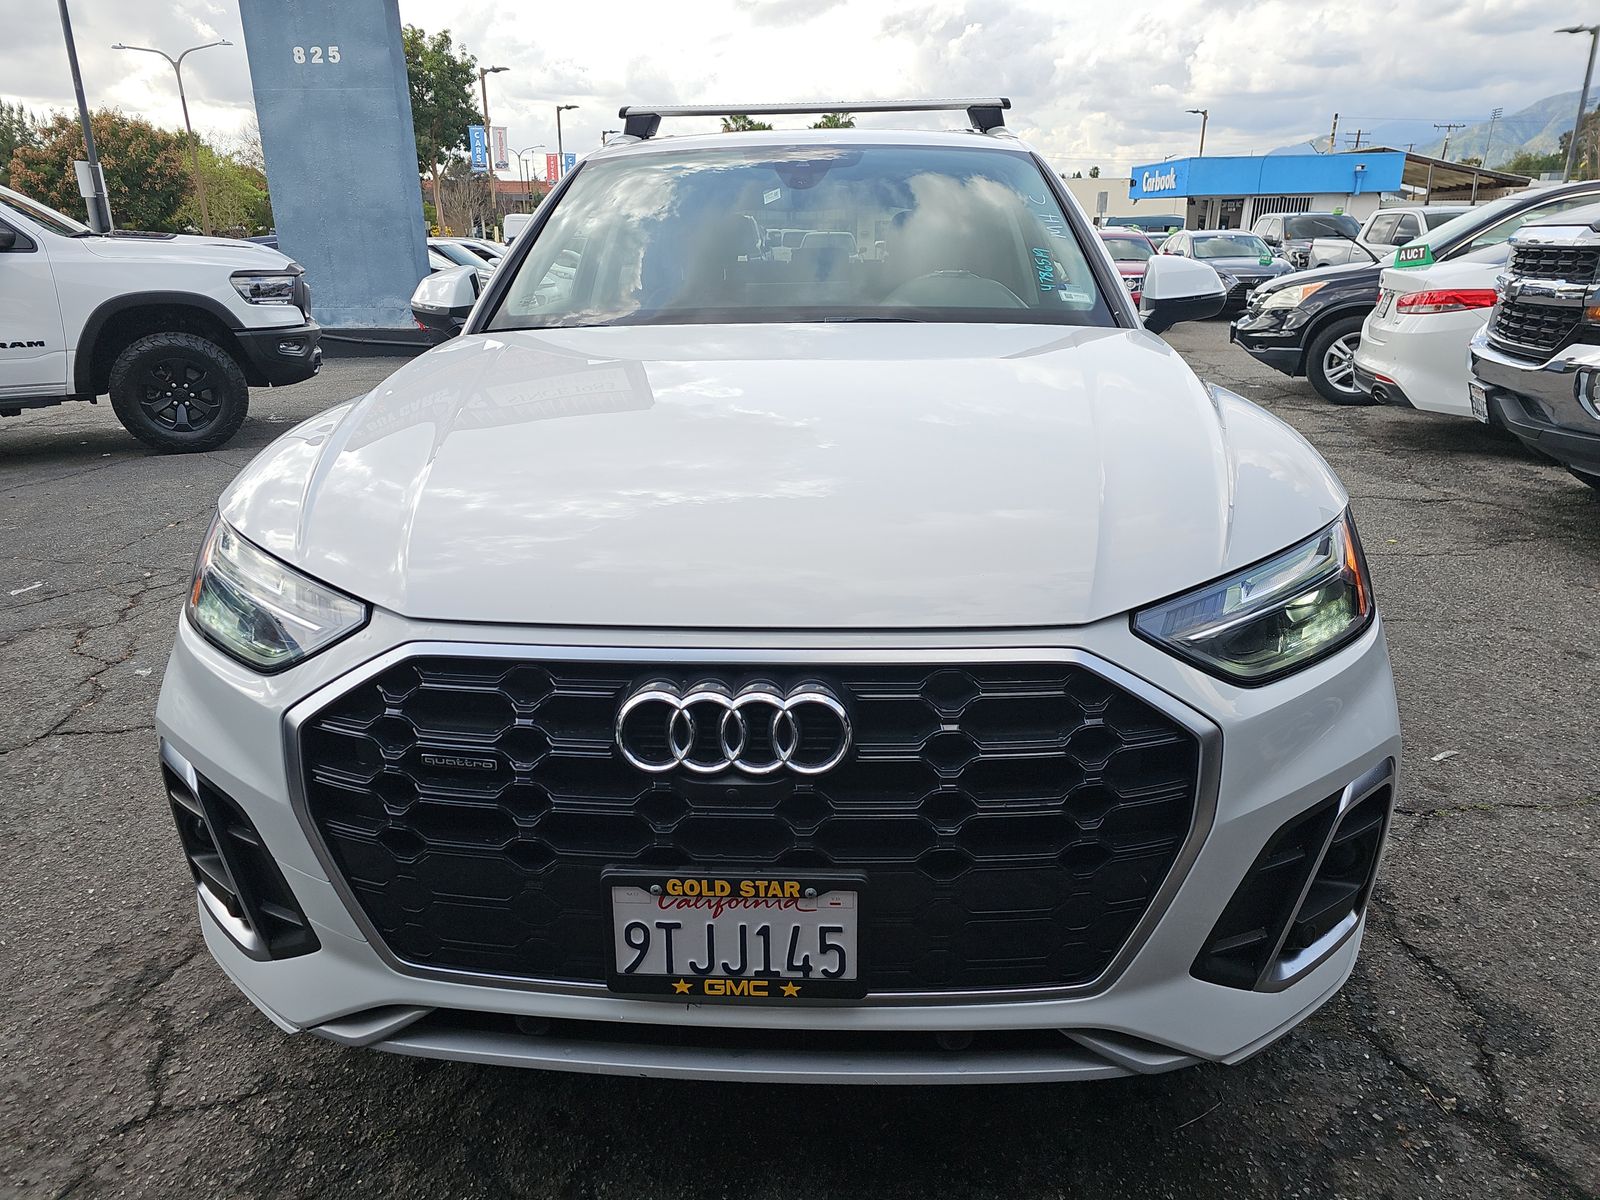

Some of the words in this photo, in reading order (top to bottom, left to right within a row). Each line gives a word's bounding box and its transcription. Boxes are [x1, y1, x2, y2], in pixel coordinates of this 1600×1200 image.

[292, 46, 341, 64] 825
[474, 132, 482, 162] CARS
[1142, 167, 1177, 192] Carbook
[1399, 247, 1425, 260] AUCT
[424, 756, 494, 769] quattro
[666, 878, 731, 897] GOLD
[739, 880, 801, 898] STAR
[657, 895, 817, 919] California
[624, 921, 848, 978] 9TJJ145
[703, 978, 770, 997] GMC
